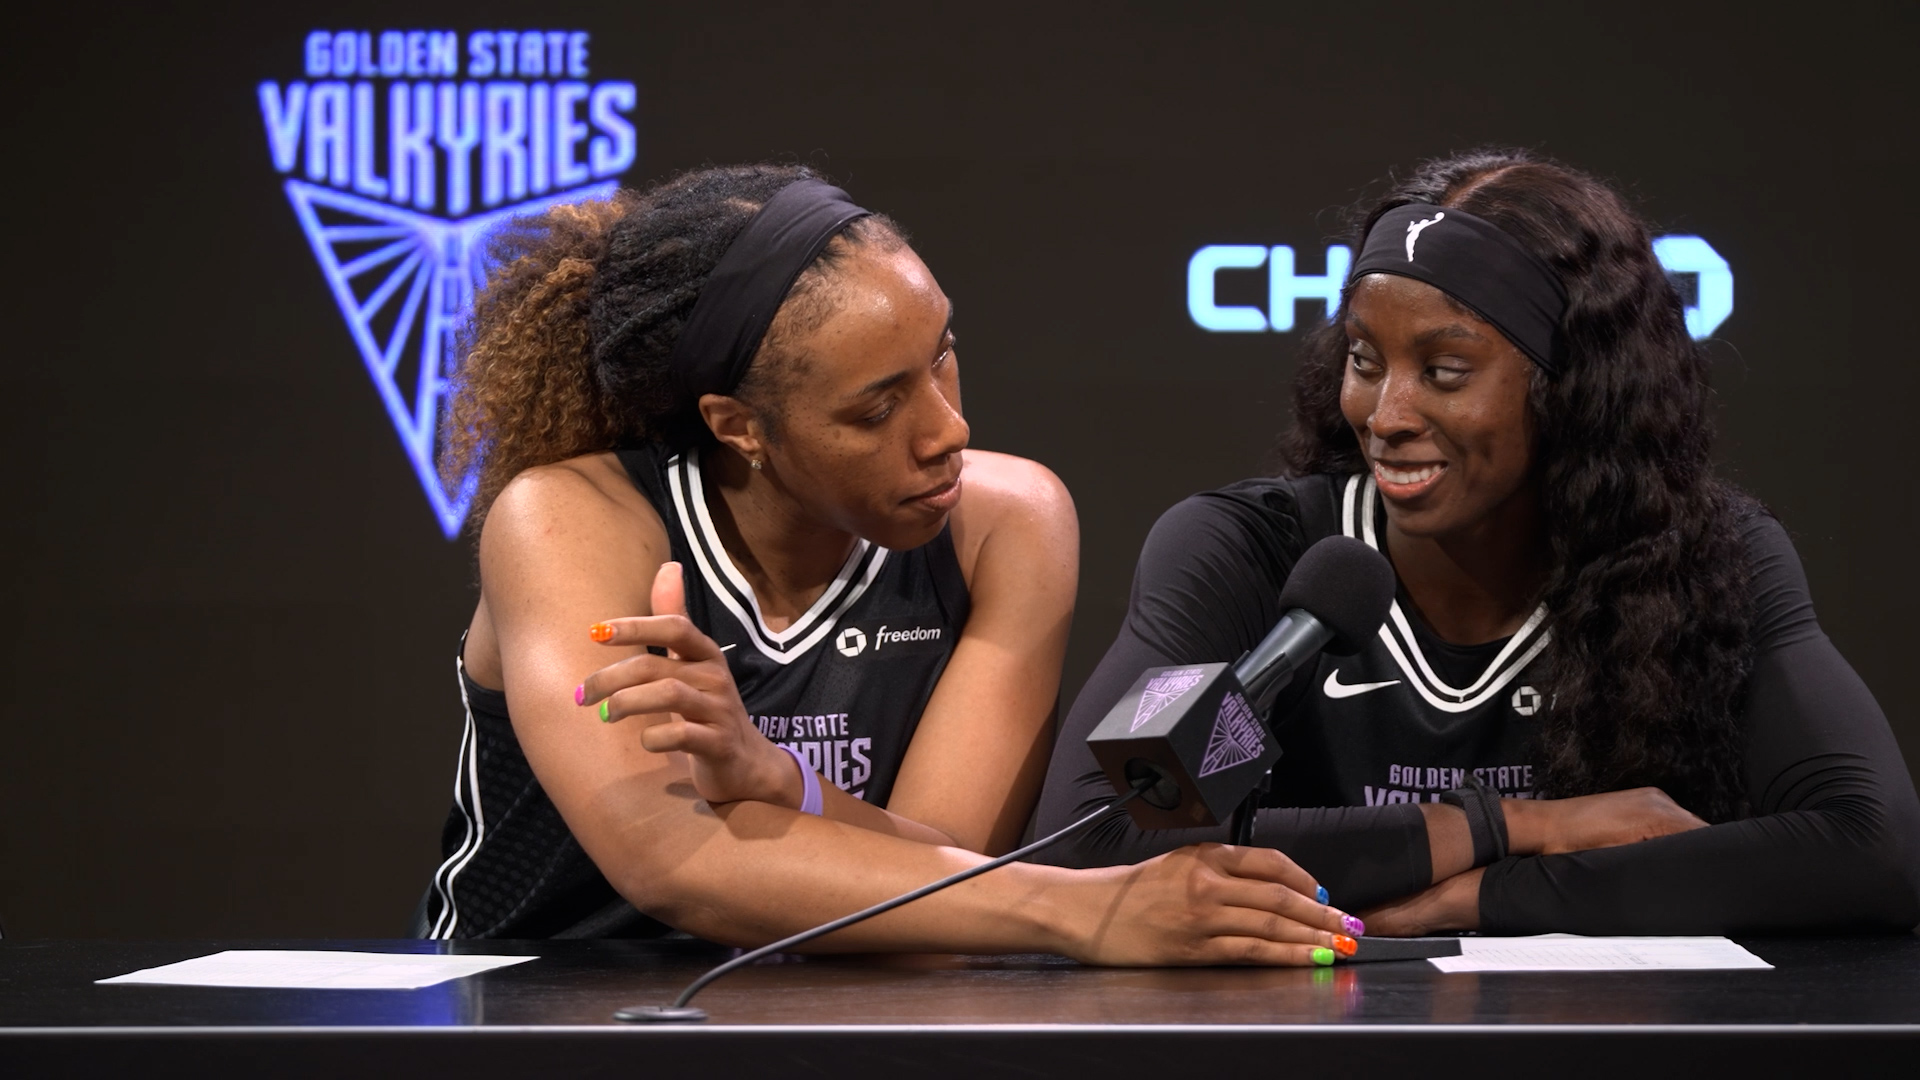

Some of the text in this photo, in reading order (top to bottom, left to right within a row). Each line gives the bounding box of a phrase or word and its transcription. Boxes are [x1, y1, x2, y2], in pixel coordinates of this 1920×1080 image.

[306, 31, 589, 77] GOLDEN STATE
[259, 80, 637, 215] VALKYRIES
[1187, 244, 1351, 332] CH
[875, 625, 941, 651] freedom
[1145, 674, 1204, 693] VALKYRIES
[791, 712, 849, 738] STATE
[1221, 691, 1266, 759] VALKYRIES
[1235, 692, 1267, 741] GOLDEN STATE
[1389, 764, 1533, 789] GOLDEN STATE
